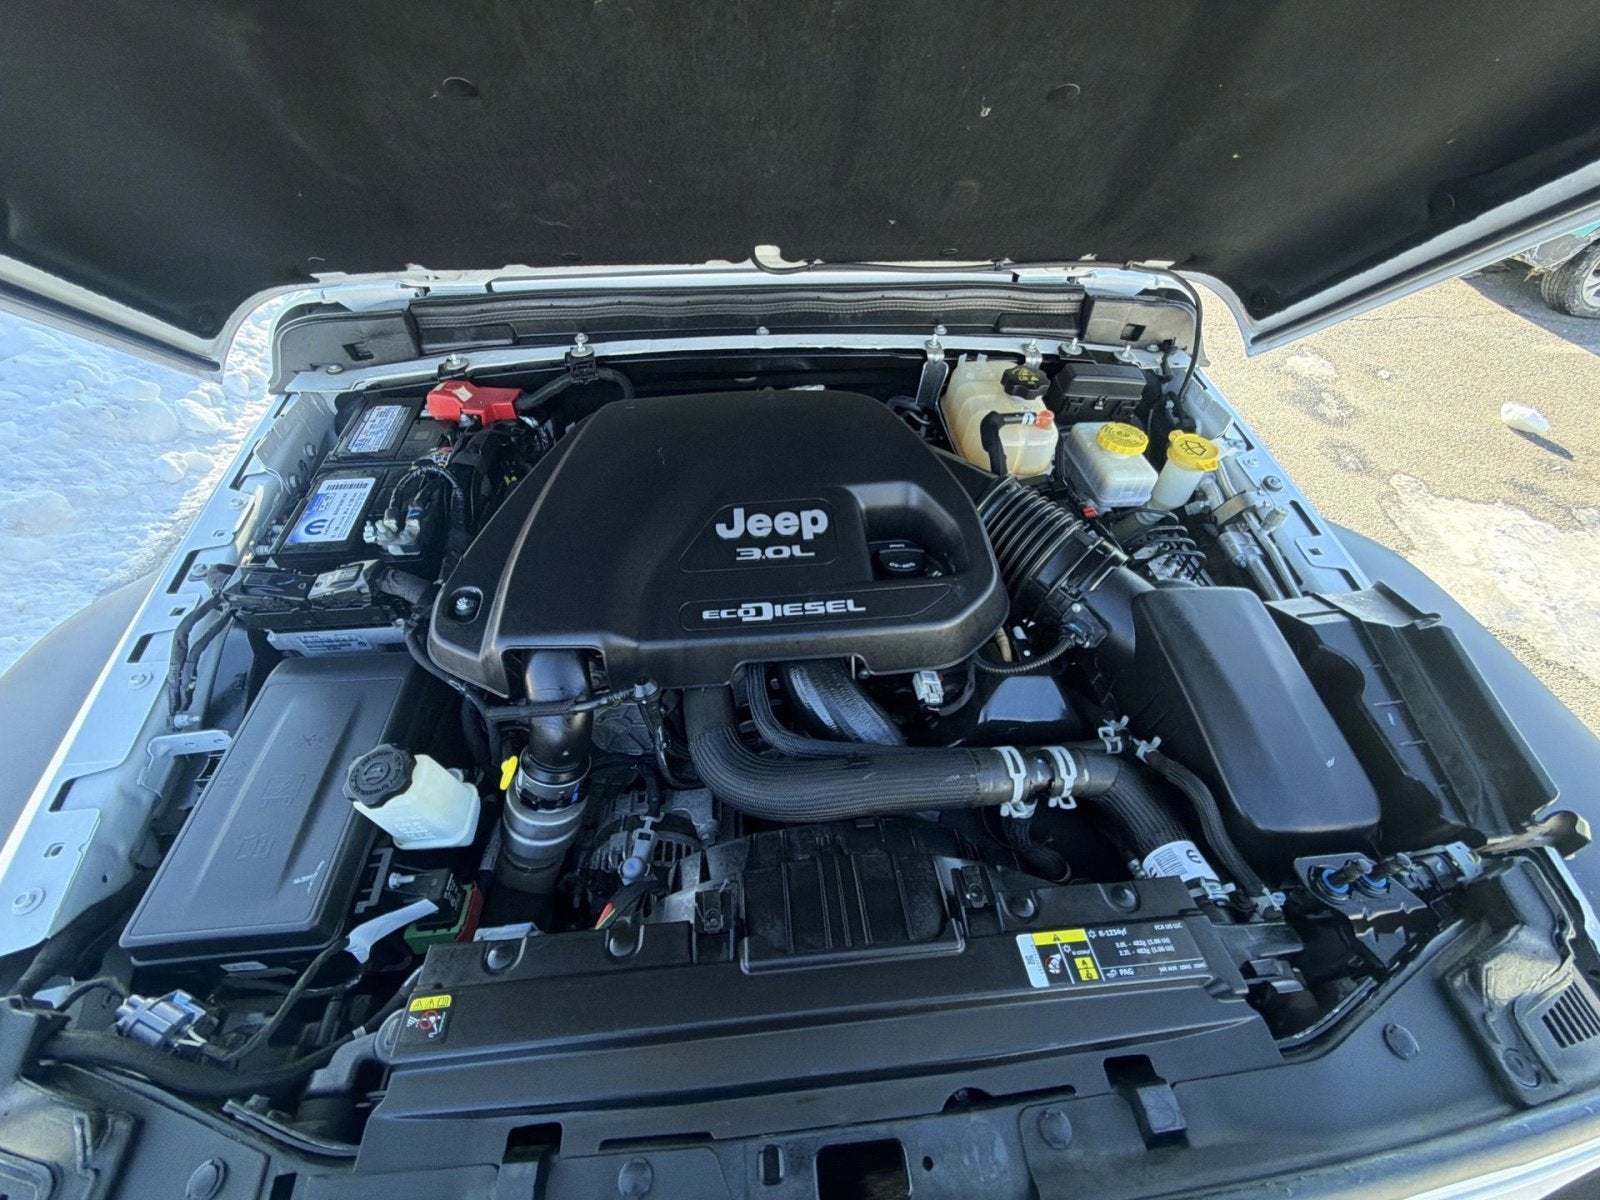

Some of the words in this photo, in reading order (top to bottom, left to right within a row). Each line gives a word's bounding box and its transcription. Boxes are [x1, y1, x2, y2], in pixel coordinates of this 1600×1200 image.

[715, 507, 828, 540] Jeep
[736, 544, 815, 561] 3.0L
[1118, 968, 1135, 976] PAG
